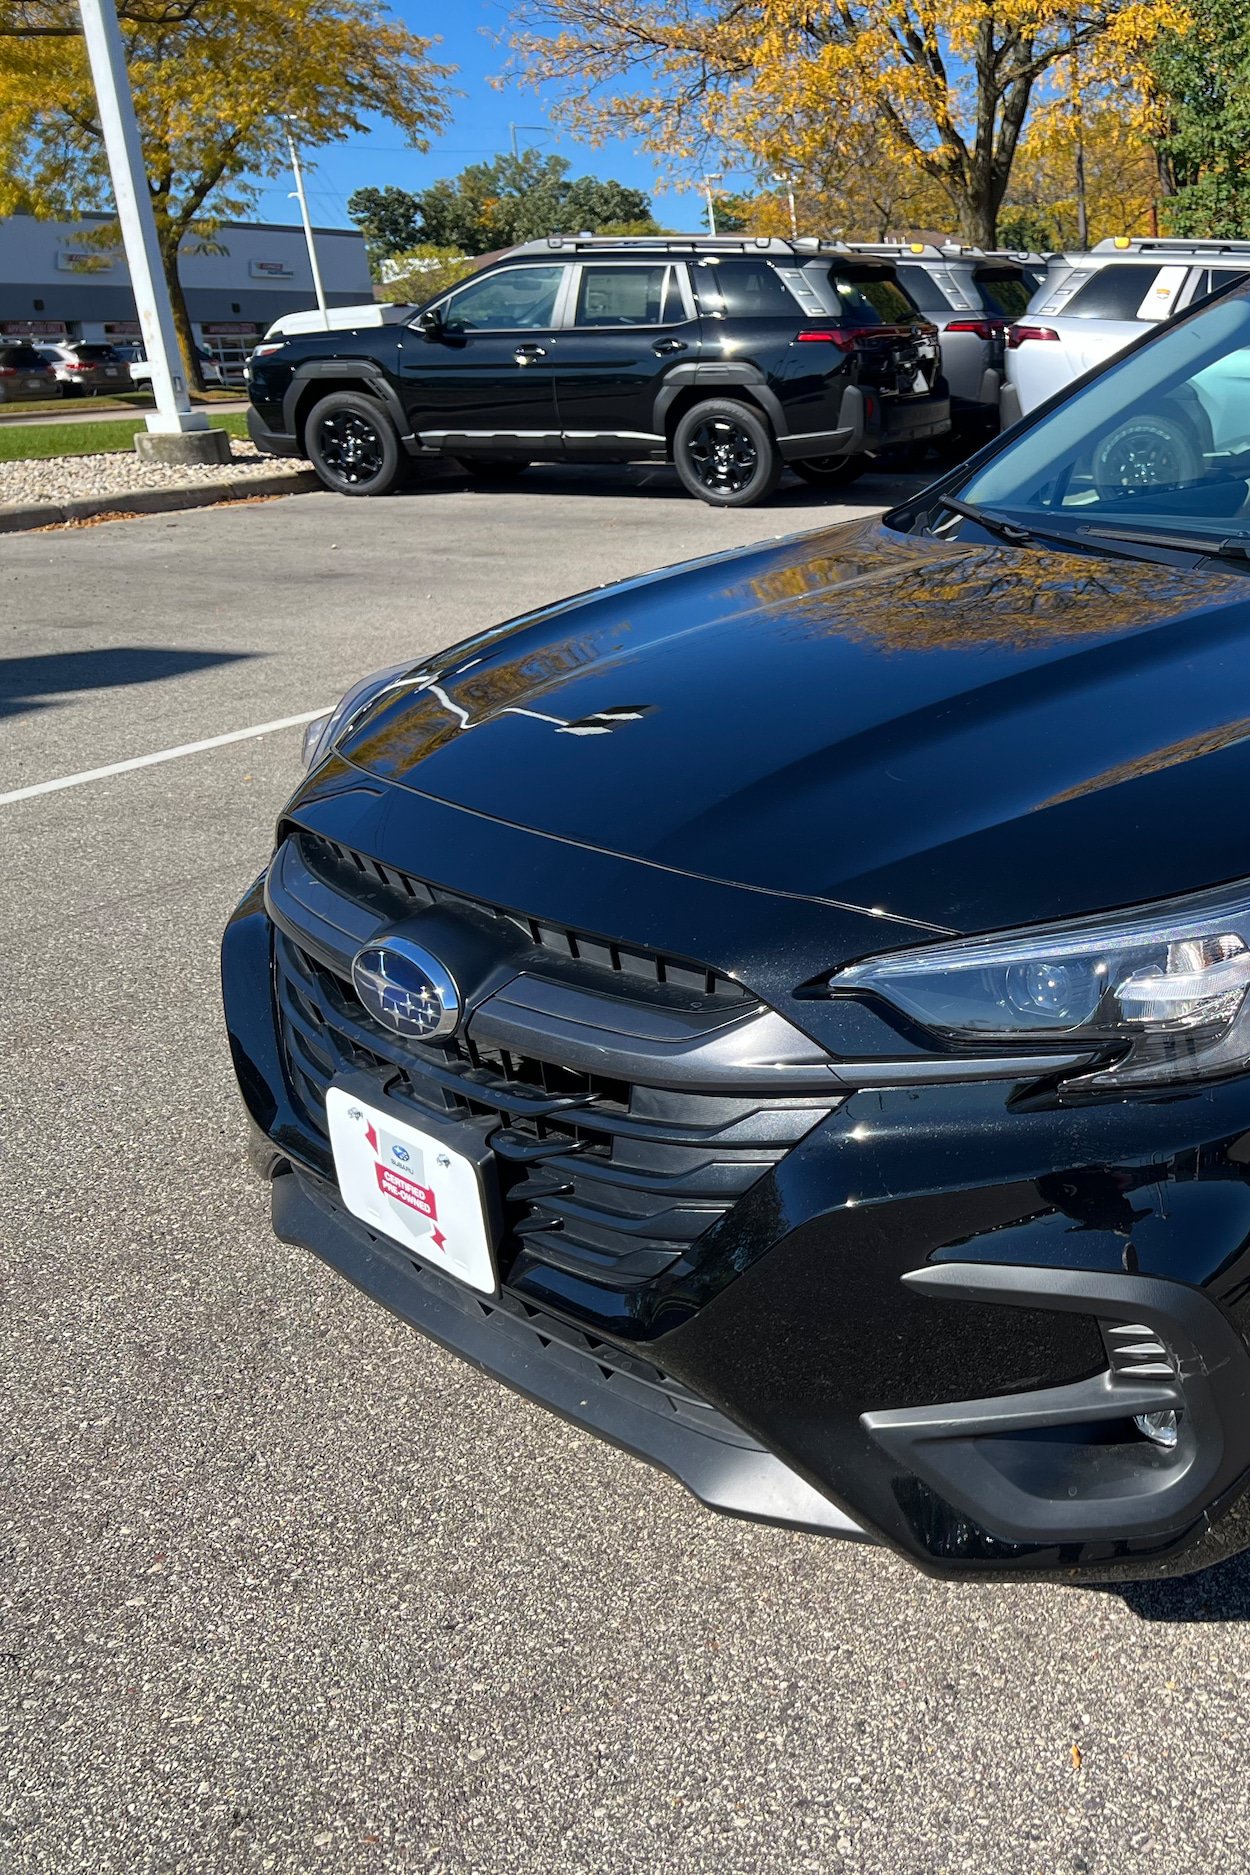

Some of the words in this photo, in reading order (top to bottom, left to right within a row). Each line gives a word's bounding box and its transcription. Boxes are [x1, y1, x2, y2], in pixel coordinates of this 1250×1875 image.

[391, 1158, 414, 1174] SUBARU
[382, 1179, 431, 1214] PRE-OWNED
[383, 1171, 426, 1201] CERTIFIED
